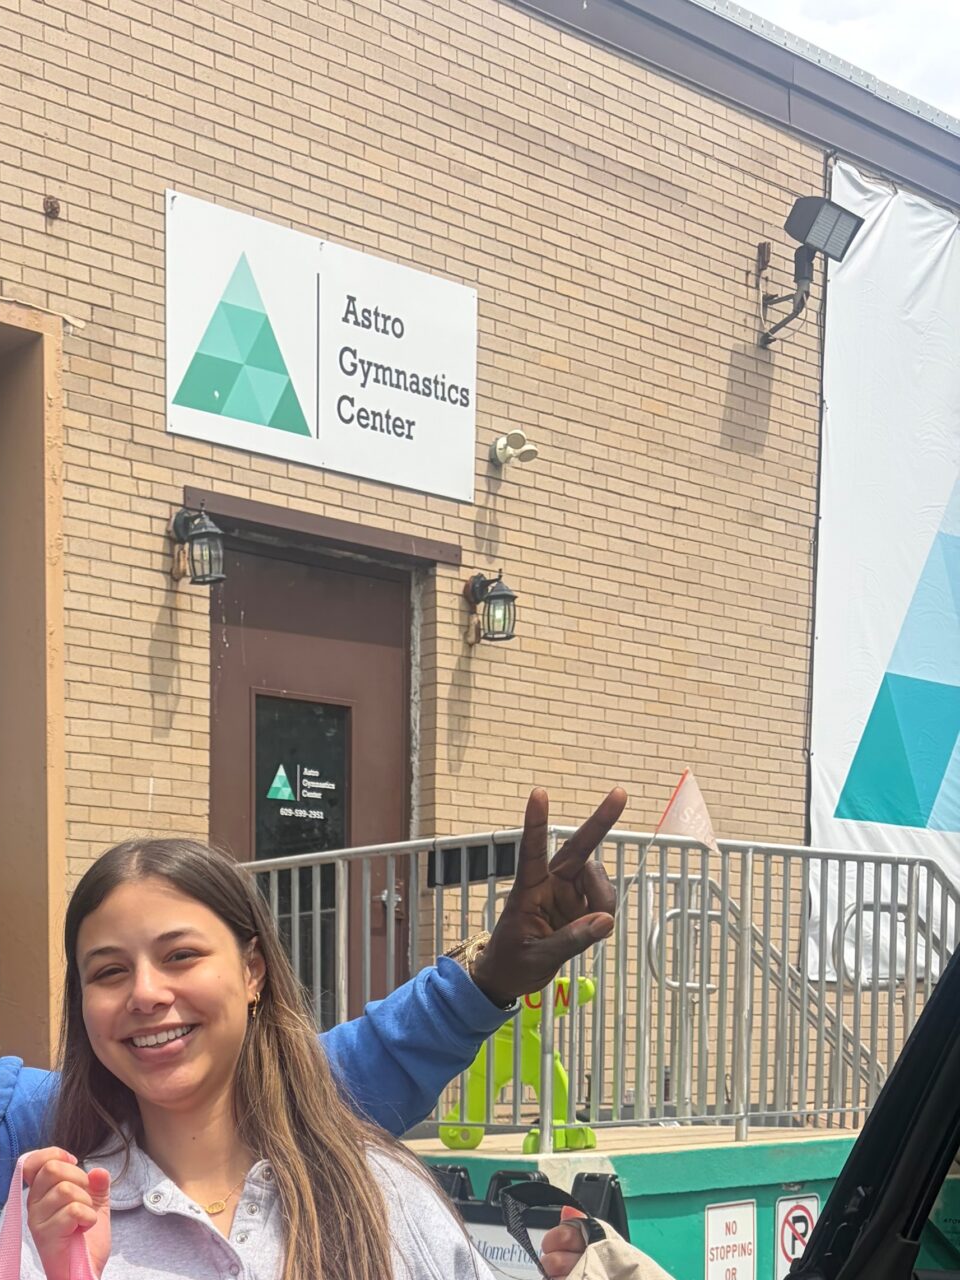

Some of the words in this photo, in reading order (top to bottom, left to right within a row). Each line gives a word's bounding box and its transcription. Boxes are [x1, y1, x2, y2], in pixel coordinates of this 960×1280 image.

[342, 295, 404, 338] Astro
[339, 346, 469, 407] Gymnastics
[337, 395, 415, 440] Center
[725, 1220, 737, 1236] NO
[709, 1241, 753, 1262] STOPPING
